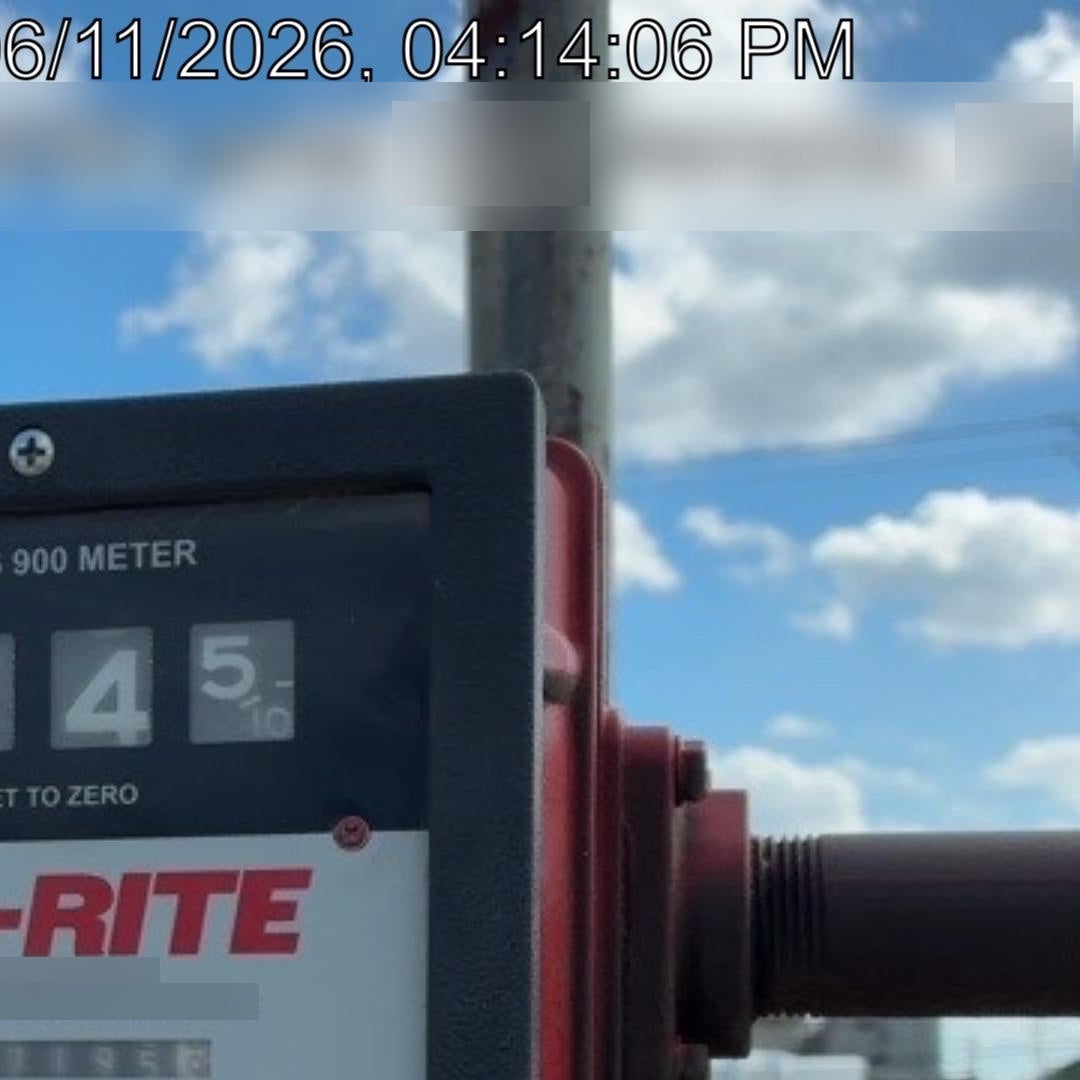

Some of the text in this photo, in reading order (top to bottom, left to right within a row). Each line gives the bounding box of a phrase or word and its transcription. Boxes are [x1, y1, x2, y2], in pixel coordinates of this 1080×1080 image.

[12, 546, 68, 575] 900
[78, 539, 198, 572] METER
[26, 786, 61, 808] TO
[68, 784, 139, 807] ZERO
